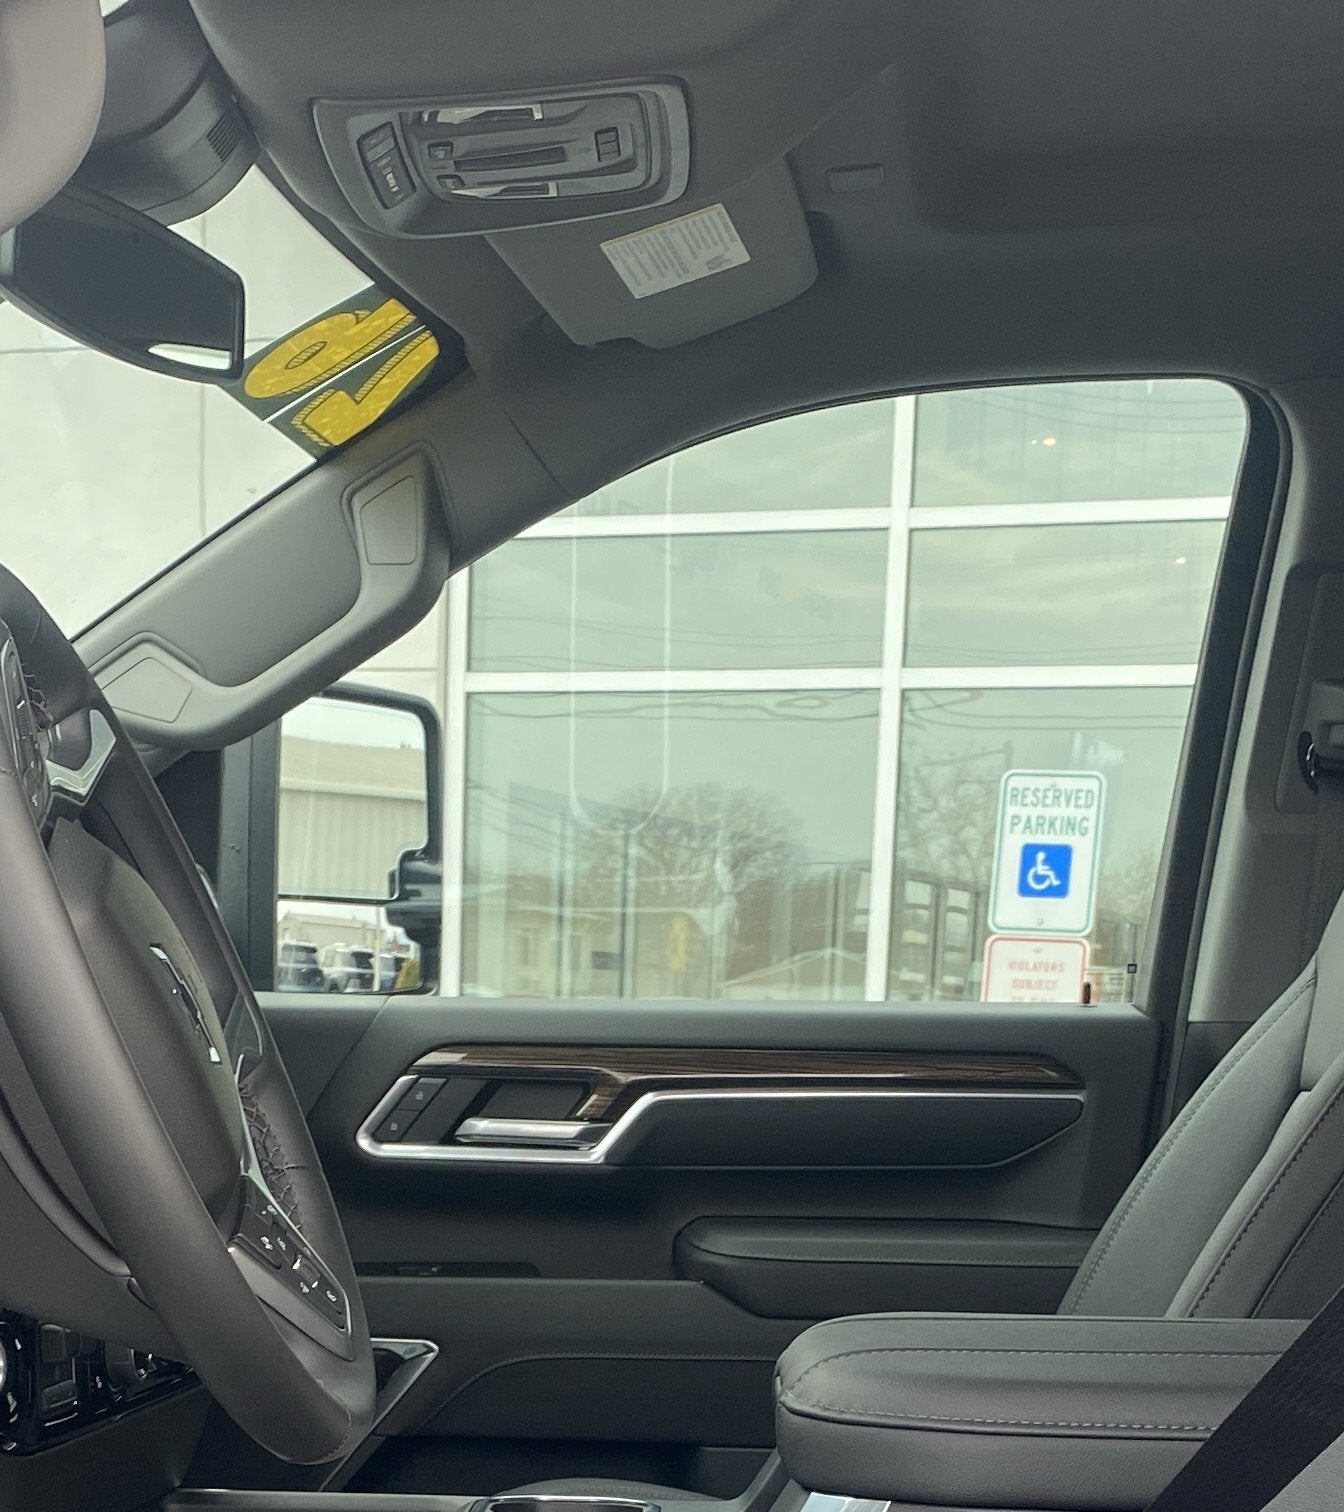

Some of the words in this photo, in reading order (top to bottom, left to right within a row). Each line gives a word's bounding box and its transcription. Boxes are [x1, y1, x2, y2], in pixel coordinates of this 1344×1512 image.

[1009, 786, 1095, 809] RESERVED
[1009, 814, 1090, 836] PARKING
[1007, 960, 1065, 973] VIOLATORS
